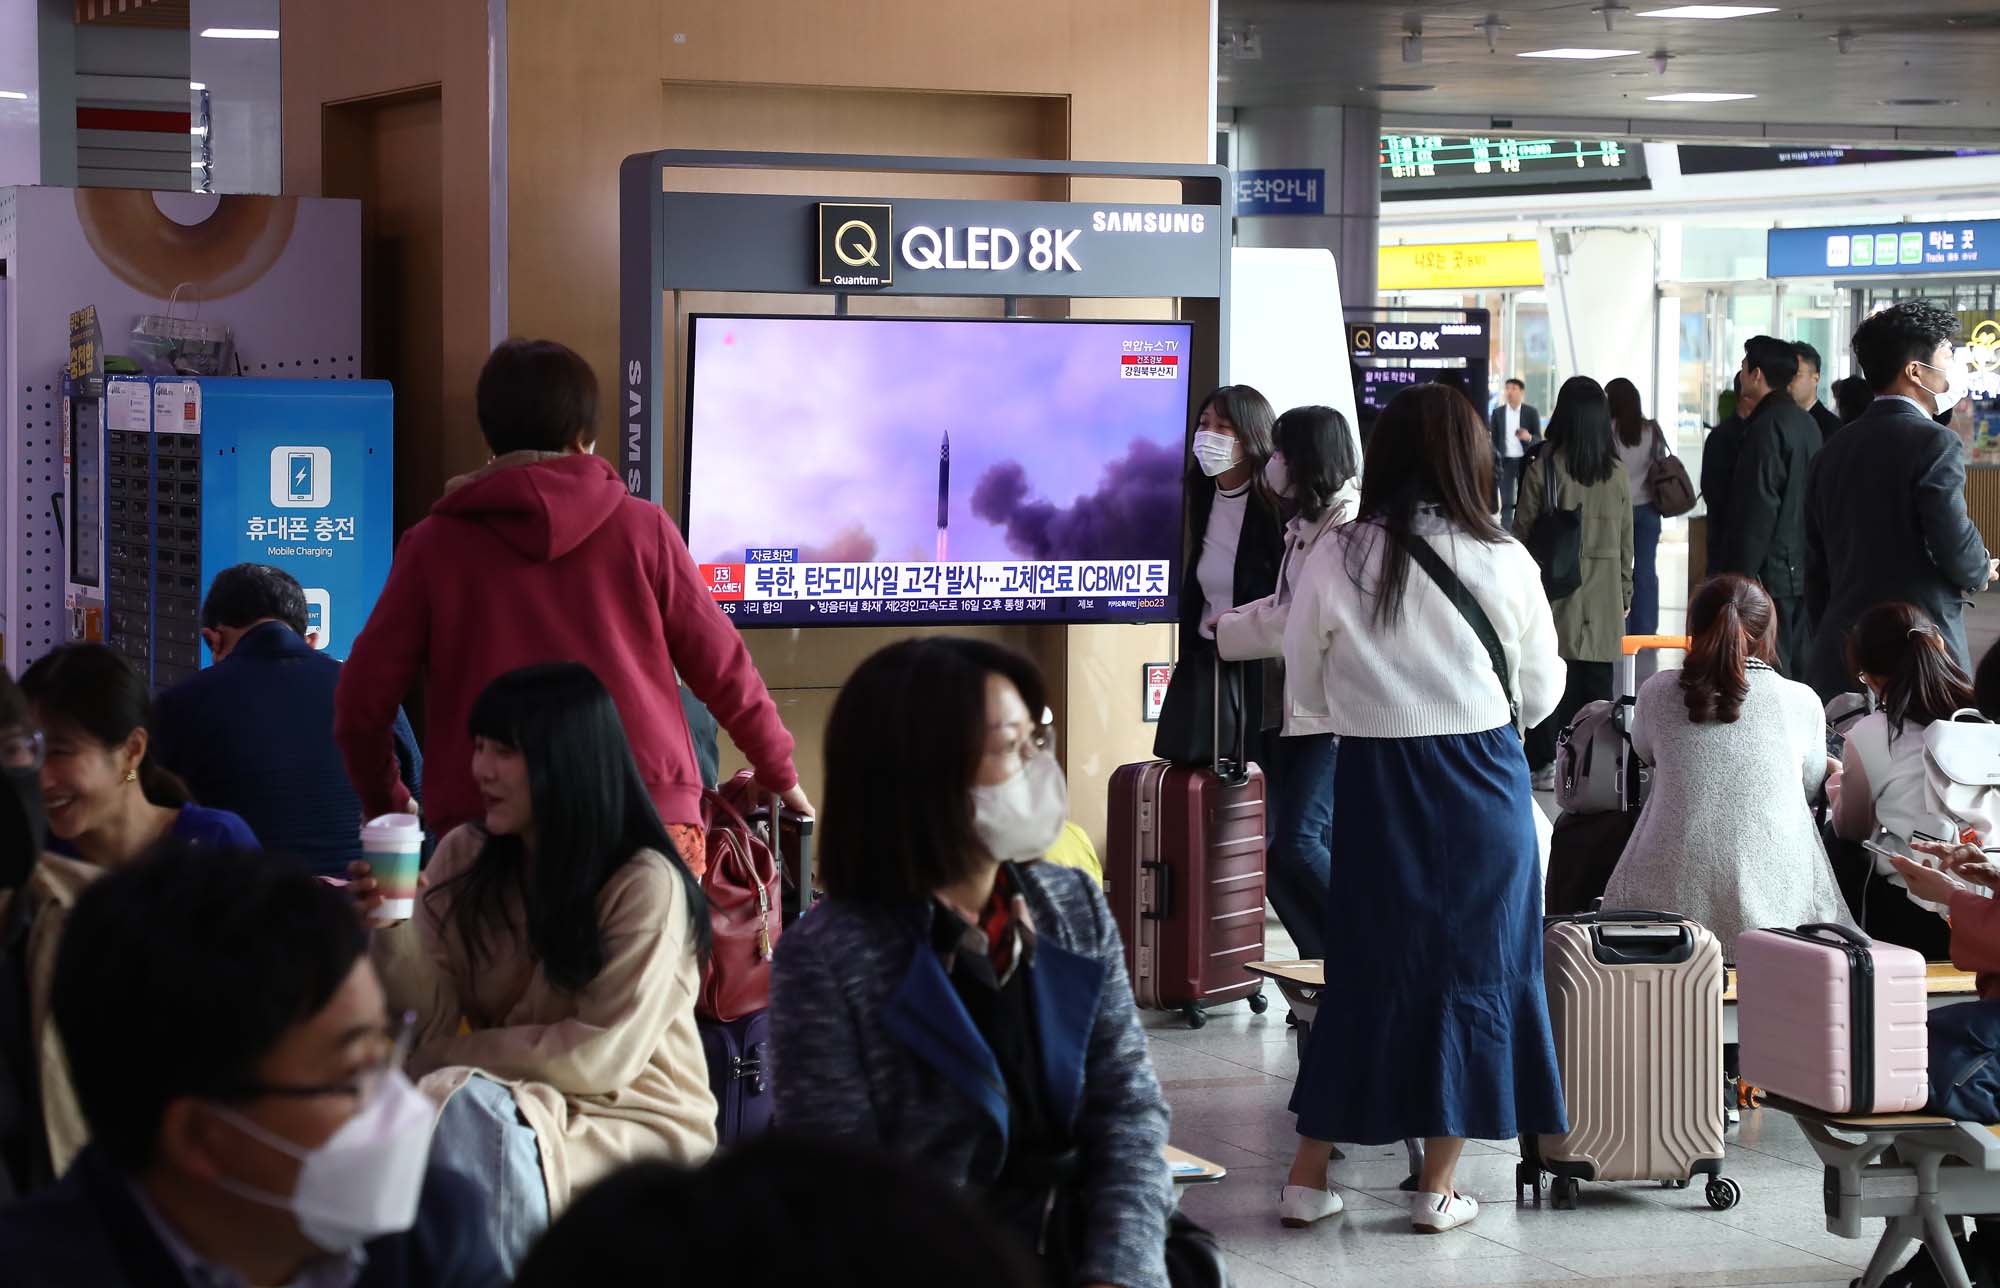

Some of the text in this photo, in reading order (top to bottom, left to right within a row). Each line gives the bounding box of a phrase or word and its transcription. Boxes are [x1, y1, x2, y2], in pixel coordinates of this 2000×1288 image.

[1233, 178, 1318, 202] 도착안내
[1092, 211, 1205, 234] SAMSUNG
[1929, 230, 1955, 250] 타는
[1961, 229, 1974, 249] 곳
[901, 225, 1082, 272] QLED 8K
[834, 275, 879, 287] Quantum
[1376, 331, 1419, 350] QLED
[1124, 366, 1174, 377] 강원북부산지
[246, 516, 355, 541] 휴대폰 충전
[267, 547, 333, 557] Mobile Charging
[751, 549, 793, 563] 자료화면
[716, 569, 729, 581] 13
[755, 566, 799, 599] 북한,
[805, 565, 898, 597] 탄도미사일
[902, 565, 942, 596] 고각
[1078, 564, 1141, 593] ICBM인
[1145, 564, 1164, 593] 듯
[762, 601, 783, 614] 합의
[884, 600, 958, 612] 제2경인고속도로
[961, 600, 980, 612] 16일
[982, 600, 1002, 612] 오후
[1004, 599, 1024, 611] 통행
[1026, 599, 1046, 611] 재개
[1077, 599, 1095, 610] 제보
[1137, 598, 1165, 610] jebo23
